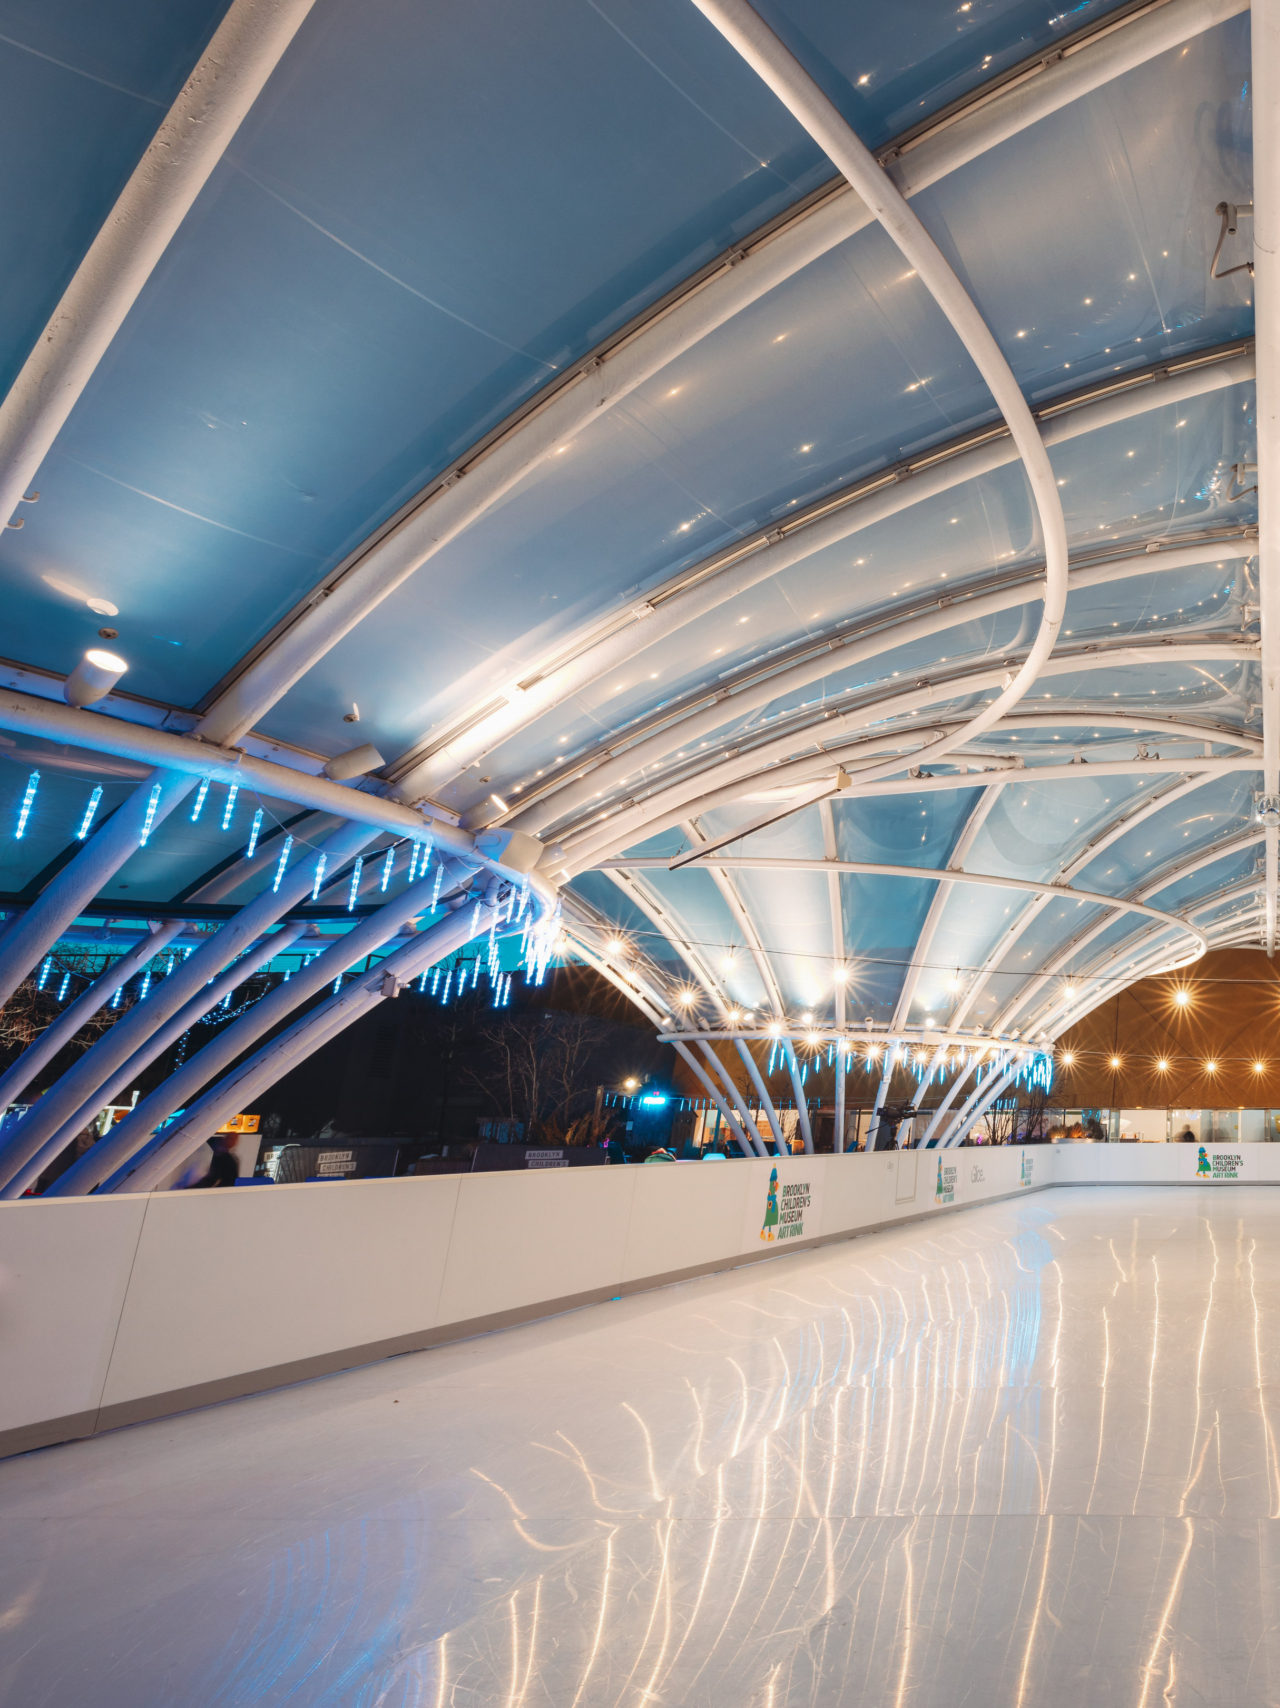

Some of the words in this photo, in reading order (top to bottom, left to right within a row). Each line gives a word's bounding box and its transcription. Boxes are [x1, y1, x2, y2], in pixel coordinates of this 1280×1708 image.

[782, 1182, 811, 1198] BROOKLYN
[780, 1195, 811, 1211] CHILDREN'S
[779, 1209, 803, 1225] MUSEUM
[777, 1224, 790, 1240] ART
[789, 1222, 804, 1237] RINK
